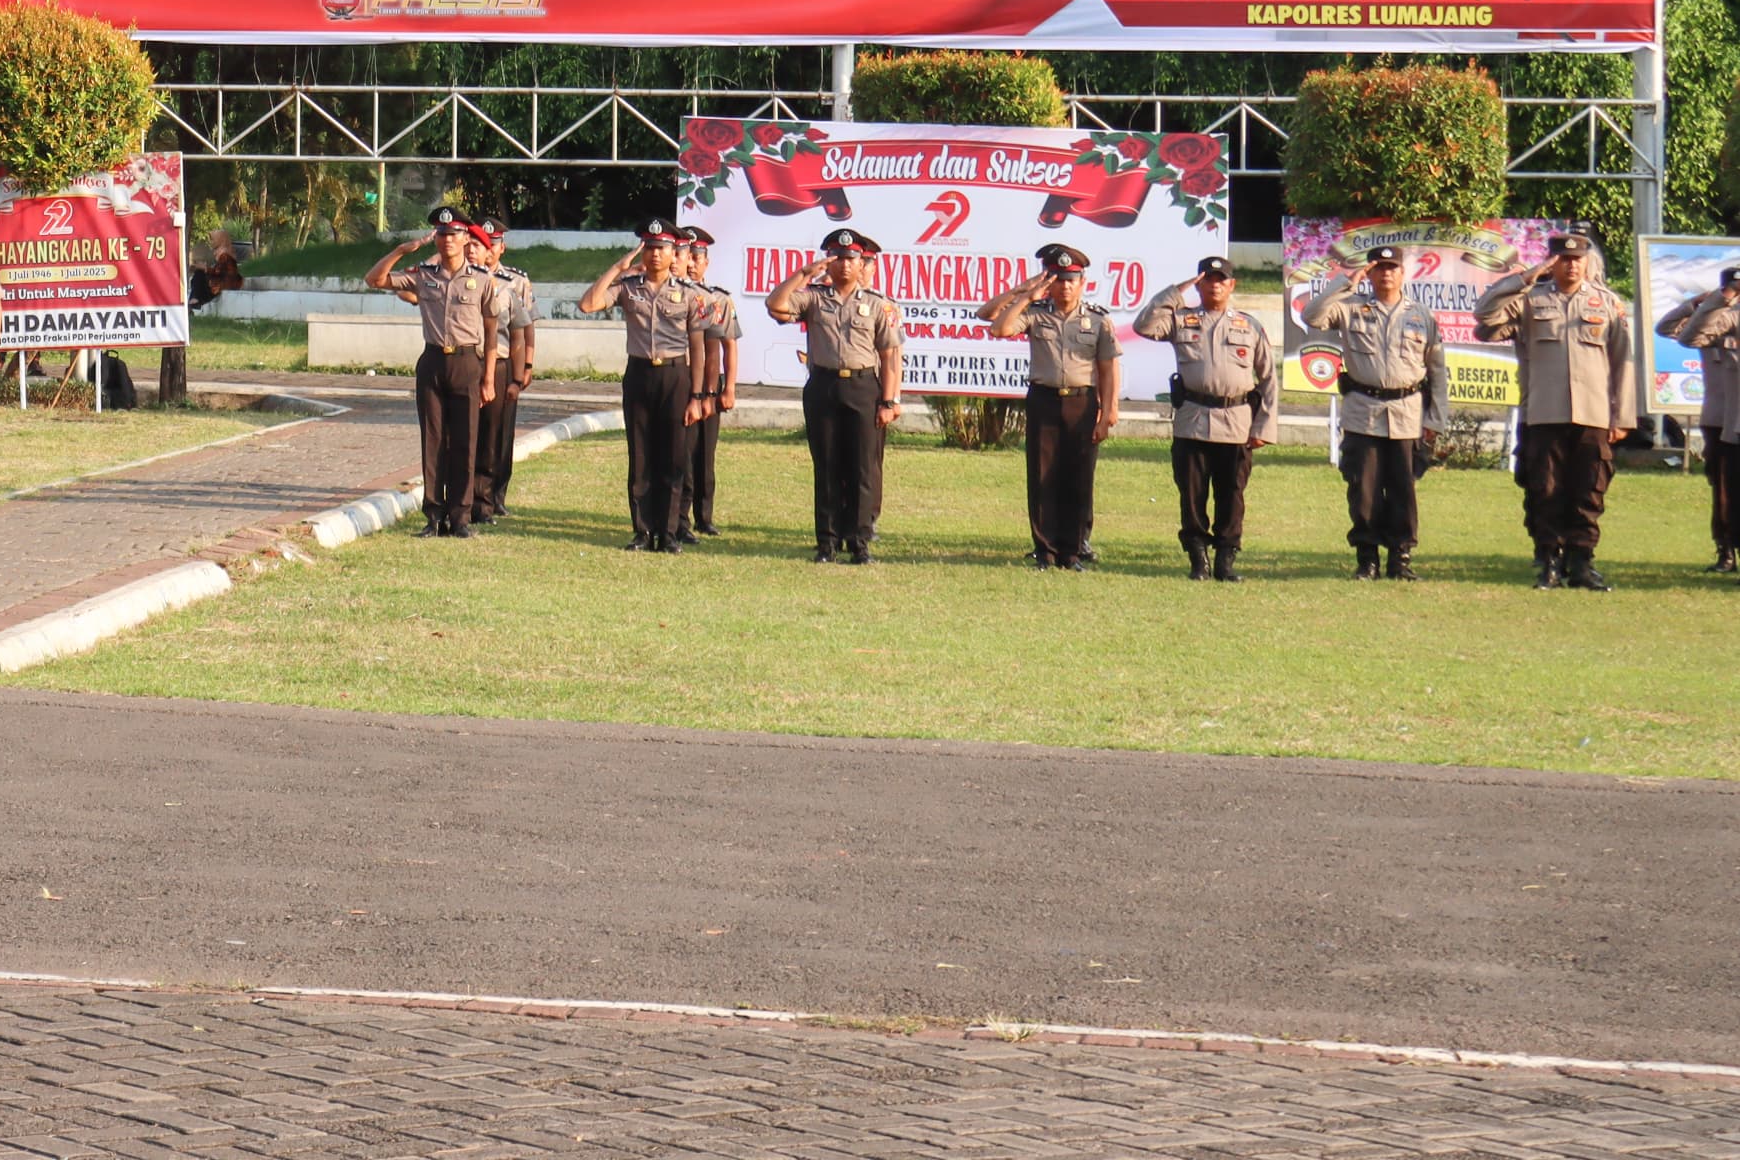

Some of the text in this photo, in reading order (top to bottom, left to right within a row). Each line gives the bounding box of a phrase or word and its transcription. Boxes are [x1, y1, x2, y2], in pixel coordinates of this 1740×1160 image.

[1247, 4, 1493, 27] KAPOLRES LUMAJANG
[822, 144, 1073, 188] Selamat dan Sukses
[1352, 228, 1419, 252] Selamat
[1423, 225, 1437, 242] &
[107, 237, 129, 261] KE
[145, 236, 166, 260] 79
[13, 270, 29, 281] Juli
[31, 269, 52, 278] 1946
[64, 268, 81, 279] Juli
[83, 267, 107, 277] 2025
[873, 253, 1029, 303] YANGKARA
[1108, 261, 1146, 307] 79
[18, 288, 55, 300] Untuk
[24, 309, 167, 333] DAMAYANTI
[904, 306, 939, 319] 1946
[960, 309, 977, 320] Ju
[18, 334, 41, 344] DPRD
[43, 333, 71, 343] Fraksi
[72, 332, 87, 342] PDI
[88, 331, 141, 344] Perjuangan
[937, 355, 996, 371] POLRES
[901, 370, 1030, 388] ERTA BHAYANGK
[1457, 367, 1510, 385] BESERTA
[1448, 383, 1507, 401] ANGKARI
